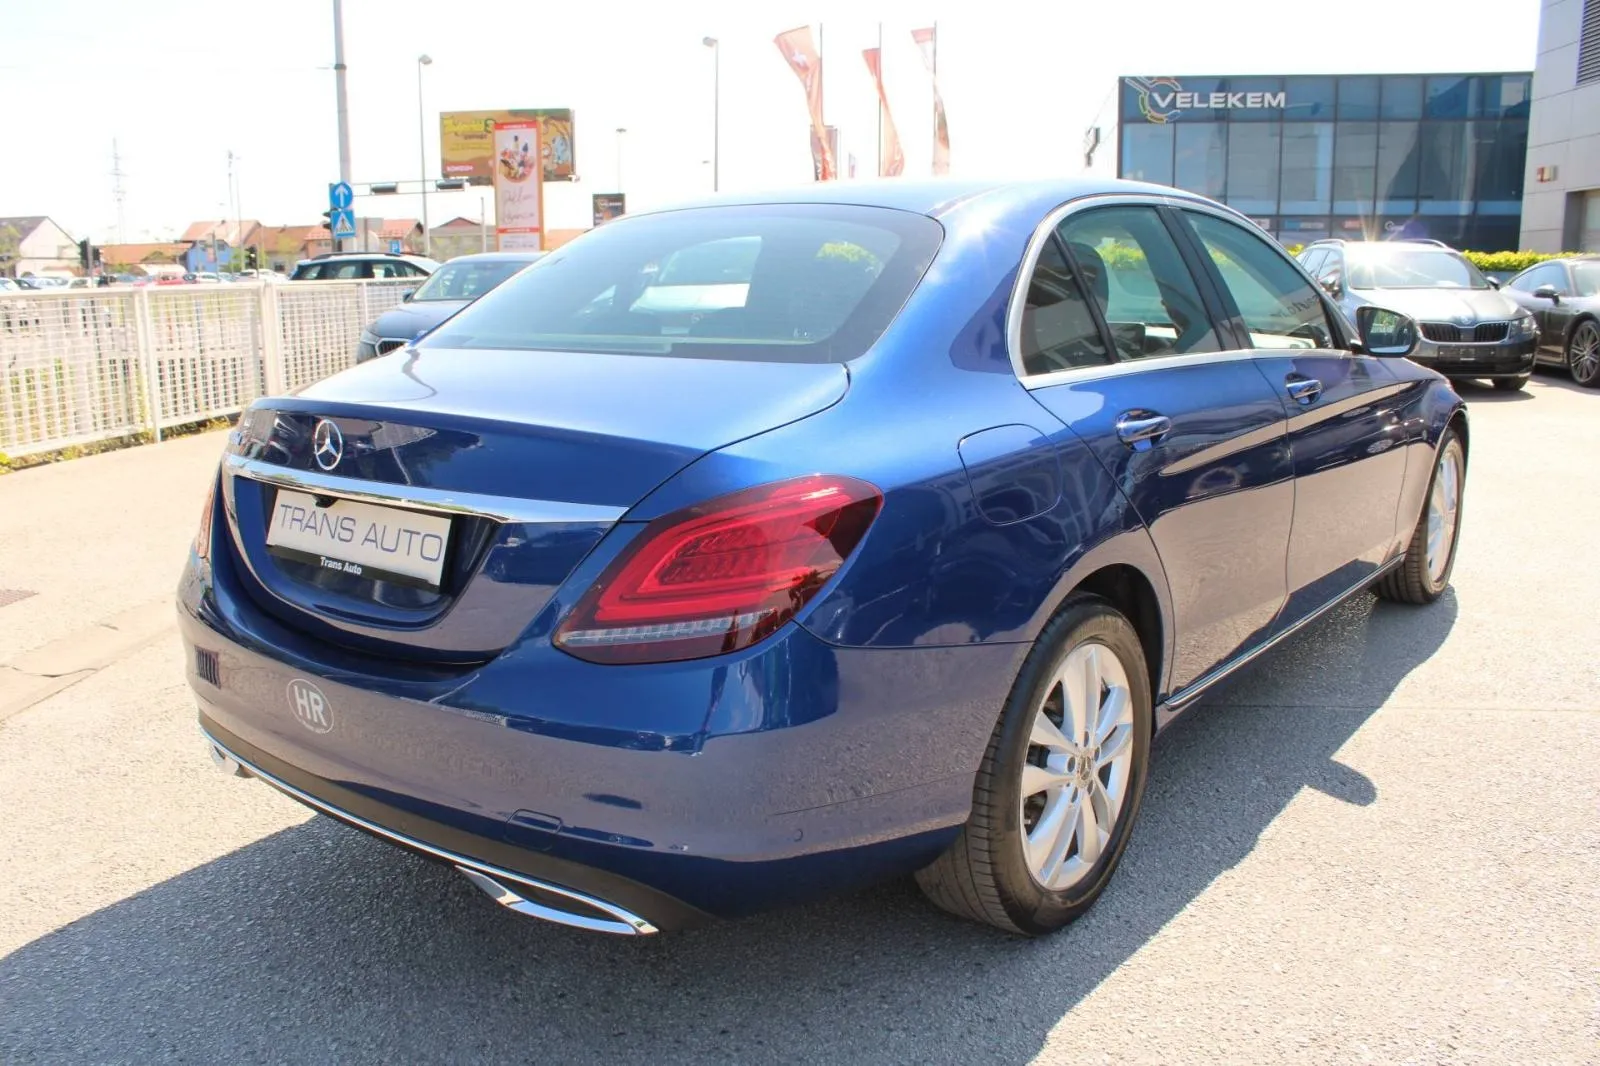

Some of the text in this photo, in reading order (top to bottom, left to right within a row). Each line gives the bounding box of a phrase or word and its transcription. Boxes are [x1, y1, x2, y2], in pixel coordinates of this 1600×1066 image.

[1152, 91, 1286, 109] VELEKEM
[280, 504, 443, 562] TRANS AUTO
[320, 557, 362, 575] Trans Auto
[293, 685, 327, 727] HR
